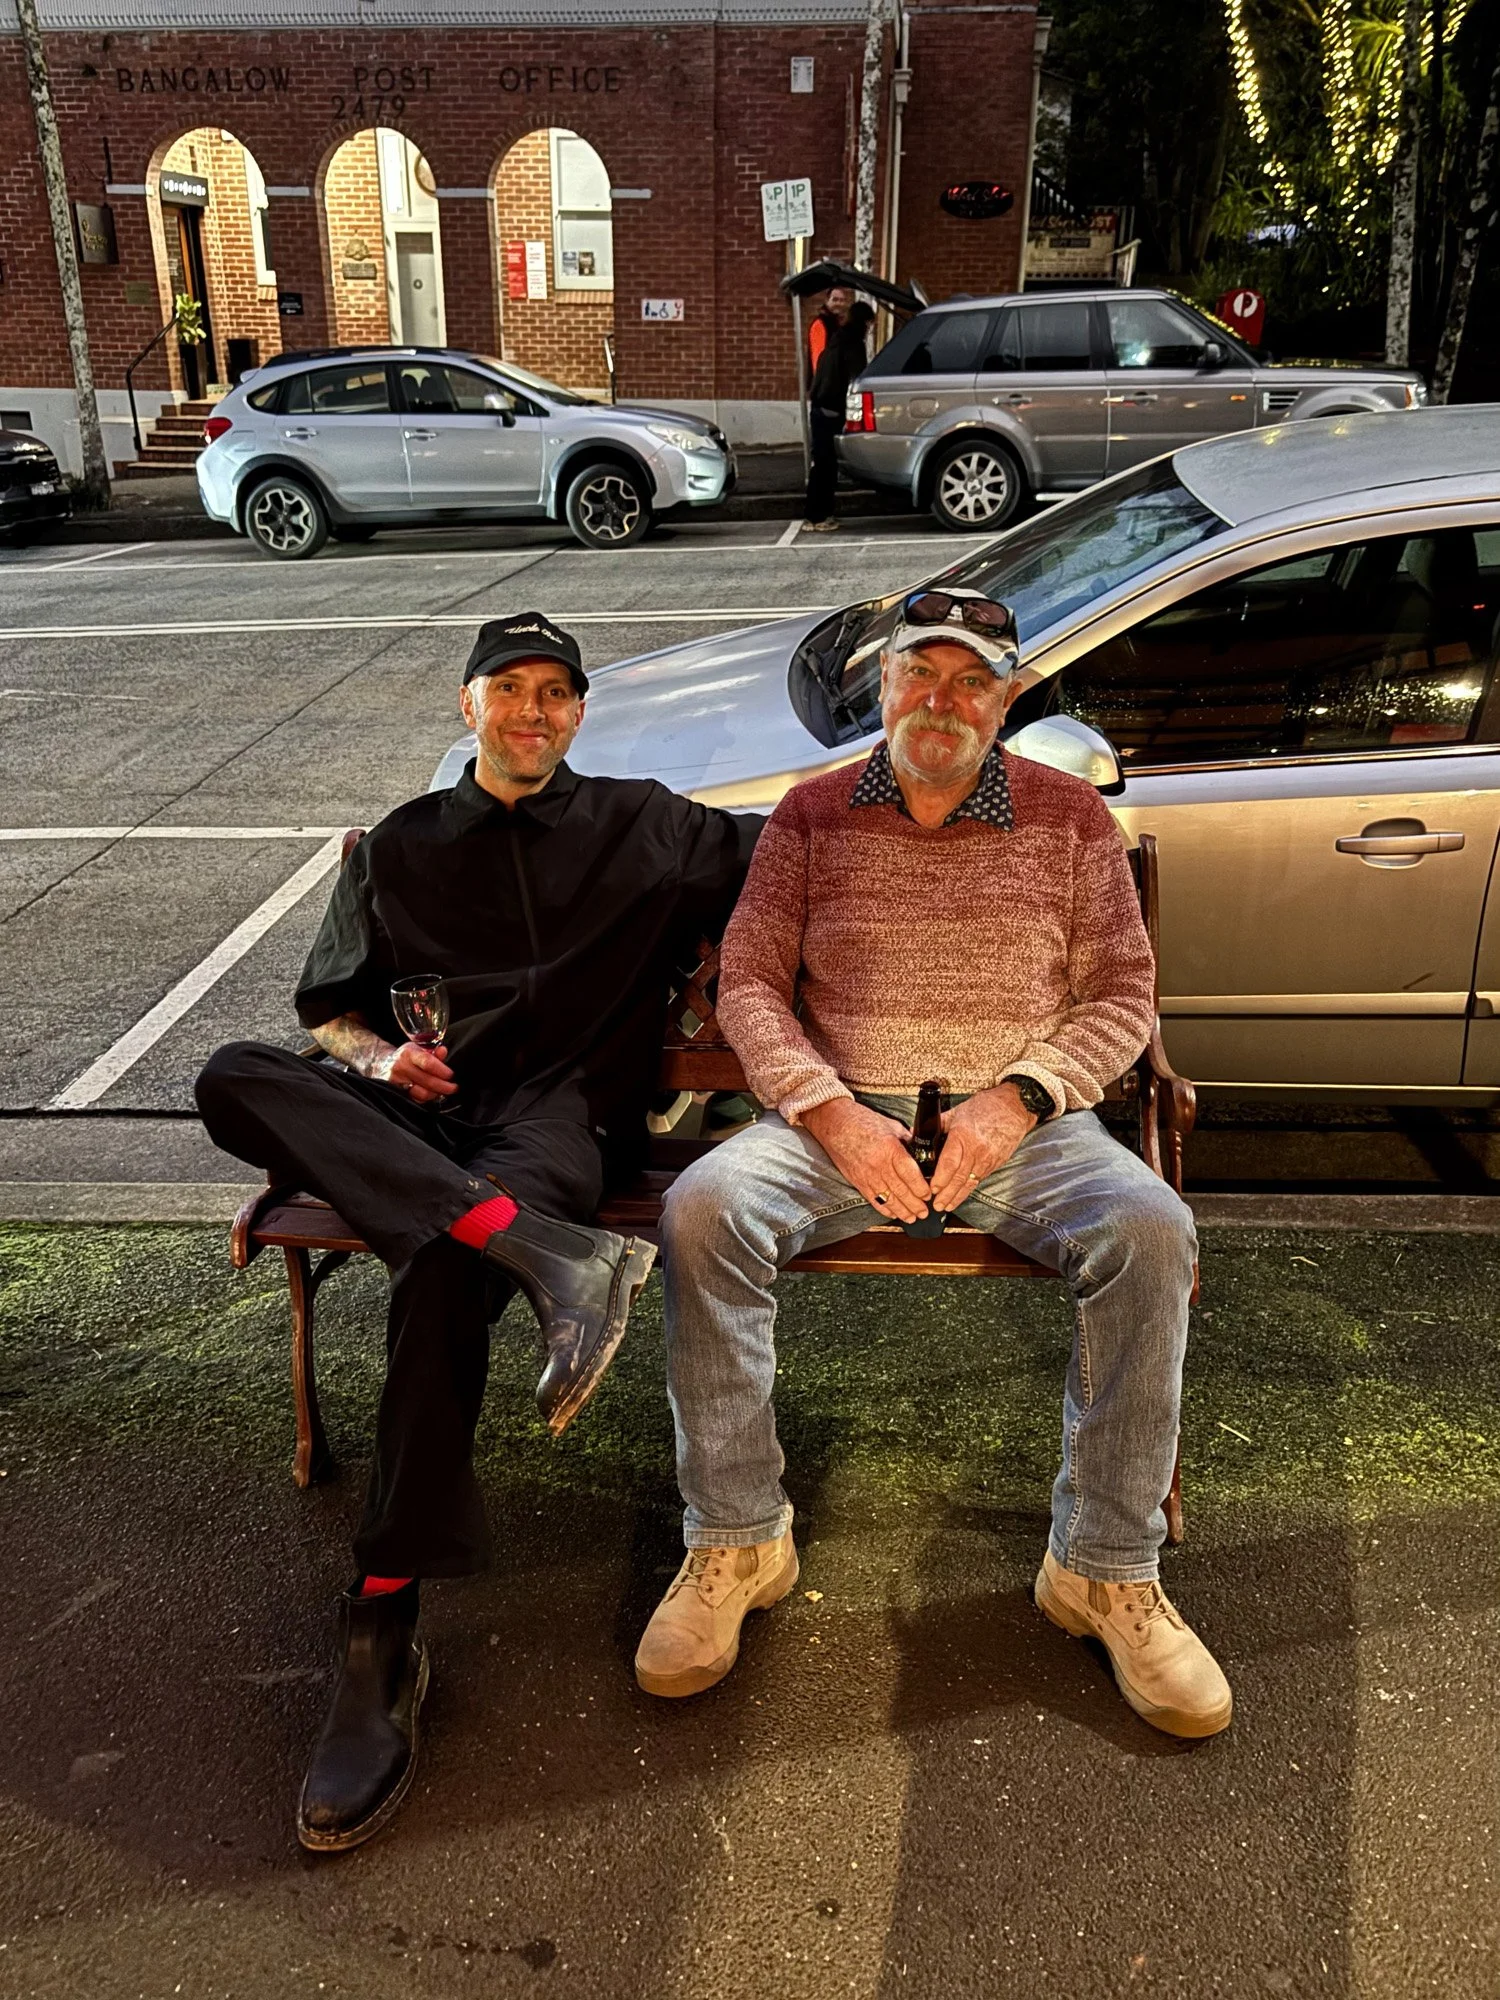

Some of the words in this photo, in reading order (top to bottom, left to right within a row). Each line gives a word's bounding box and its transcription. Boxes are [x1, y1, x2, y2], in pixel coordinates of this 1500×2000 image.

[116, 67, 290, 93] BANGALOW
[354, 67, 435, 92] POST
[499, 66, 621, 92] OFFICE
[332, 94, 405, 119] 2479
[791, 183, 806, 198] 1P
